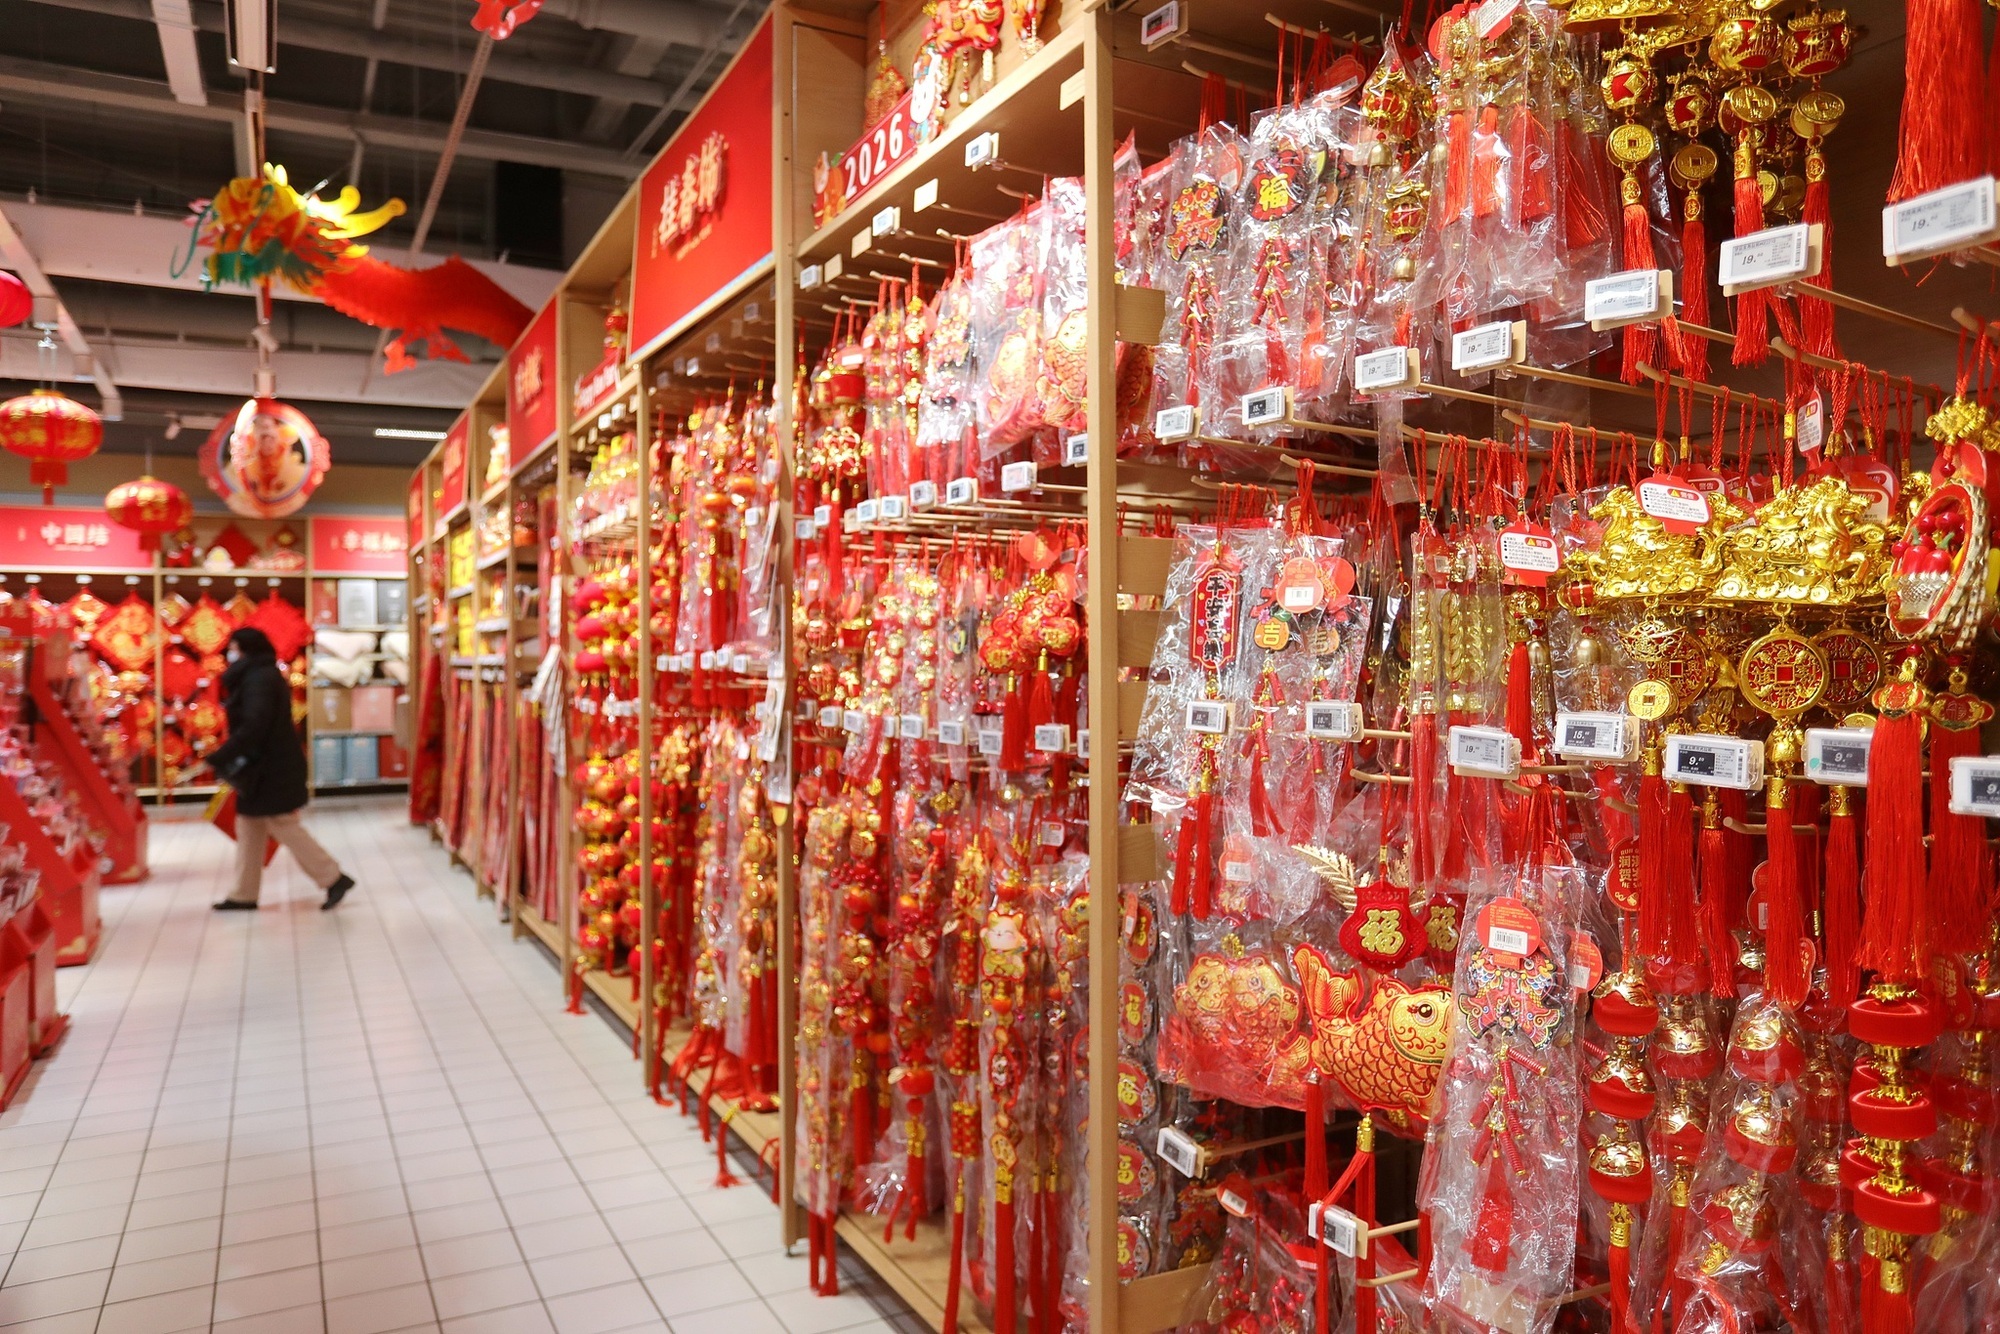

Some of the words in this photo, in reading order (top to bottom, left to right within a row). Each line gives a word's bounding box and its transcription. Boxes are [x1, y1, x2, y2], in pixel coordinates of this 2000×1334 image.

[845, 113, 903, 200] 2026
[1260, 173, 1288, 211] 福
[41, 521, 110, 546] 中国结
[1263, 622, 1281, 646] 吉
[1358, 909, 1404, 955] 福
[1425, 906, 1459, 952] 福
